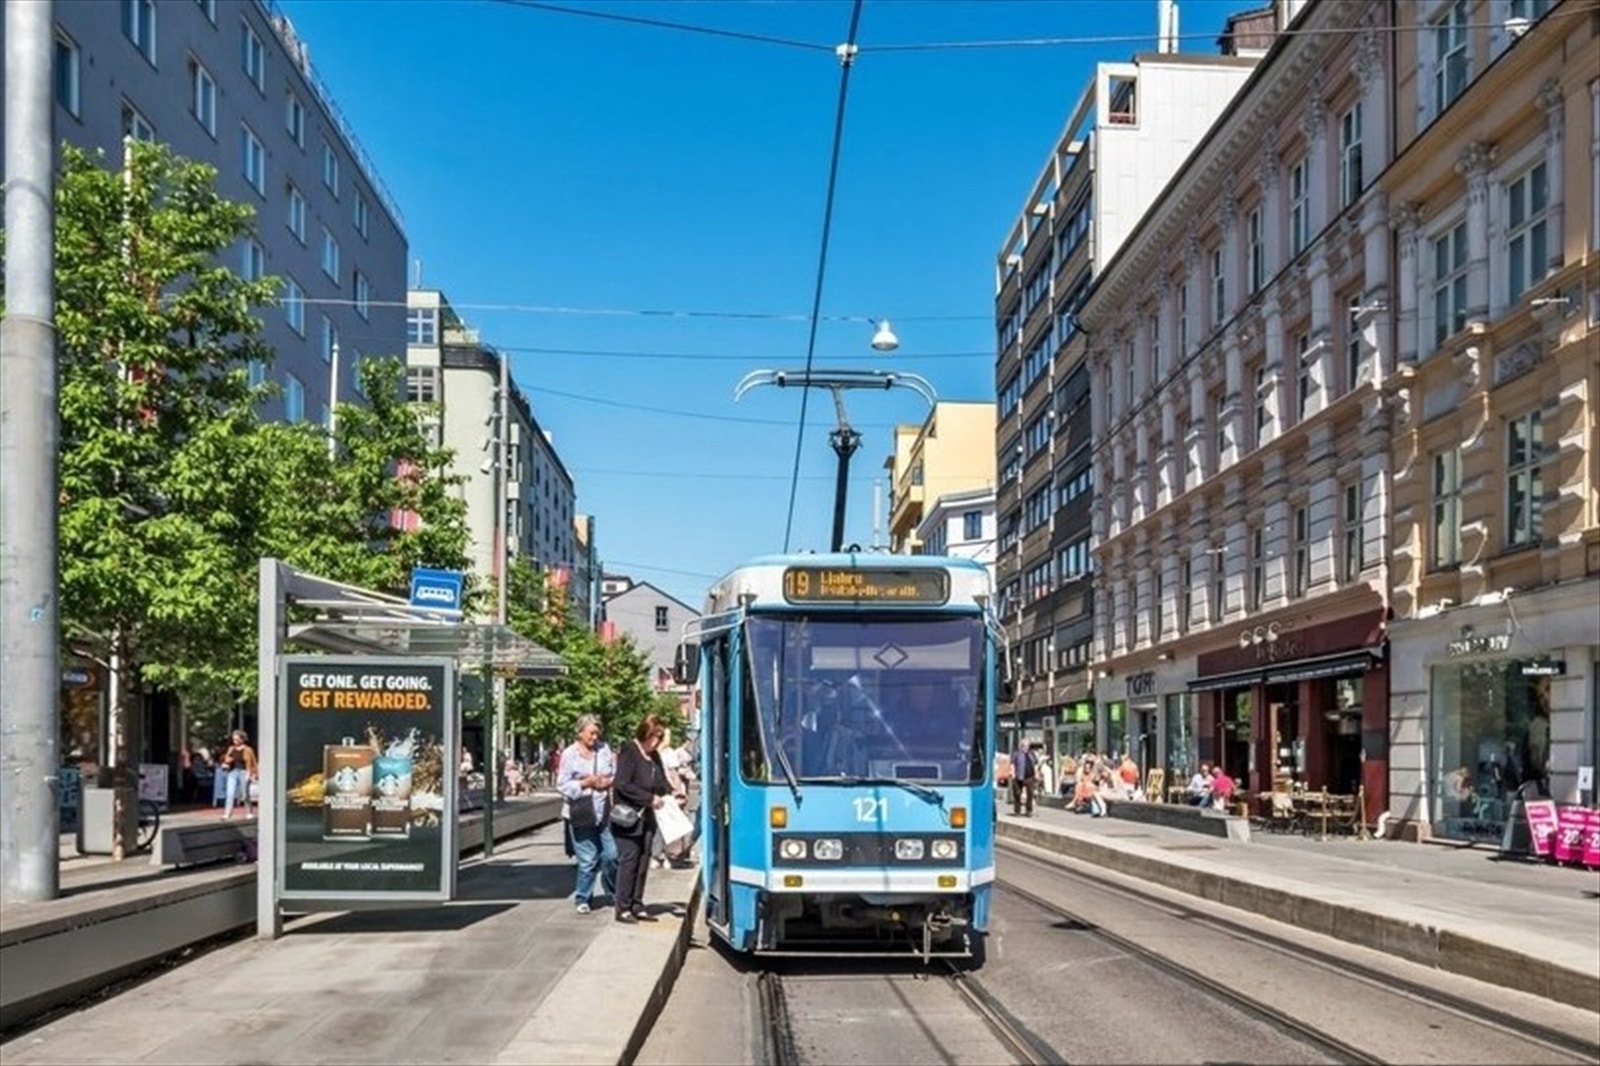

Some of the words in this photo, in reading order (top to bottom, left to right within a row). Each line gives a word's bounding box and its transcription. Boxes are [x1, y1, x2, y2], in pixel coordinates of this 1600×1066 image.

[785, 571, 809, 596] 19
[299, 674, 324, 688] GET
[326, 674, 358, 689] ONE.
[360, 675, 384, 689] GET
[386, 676, 432, 690] GOING.
[299, 691, 331, 708] GET
[334, 692, 431, 710] REWARDED.
[852, 797, 888, 822] 121
